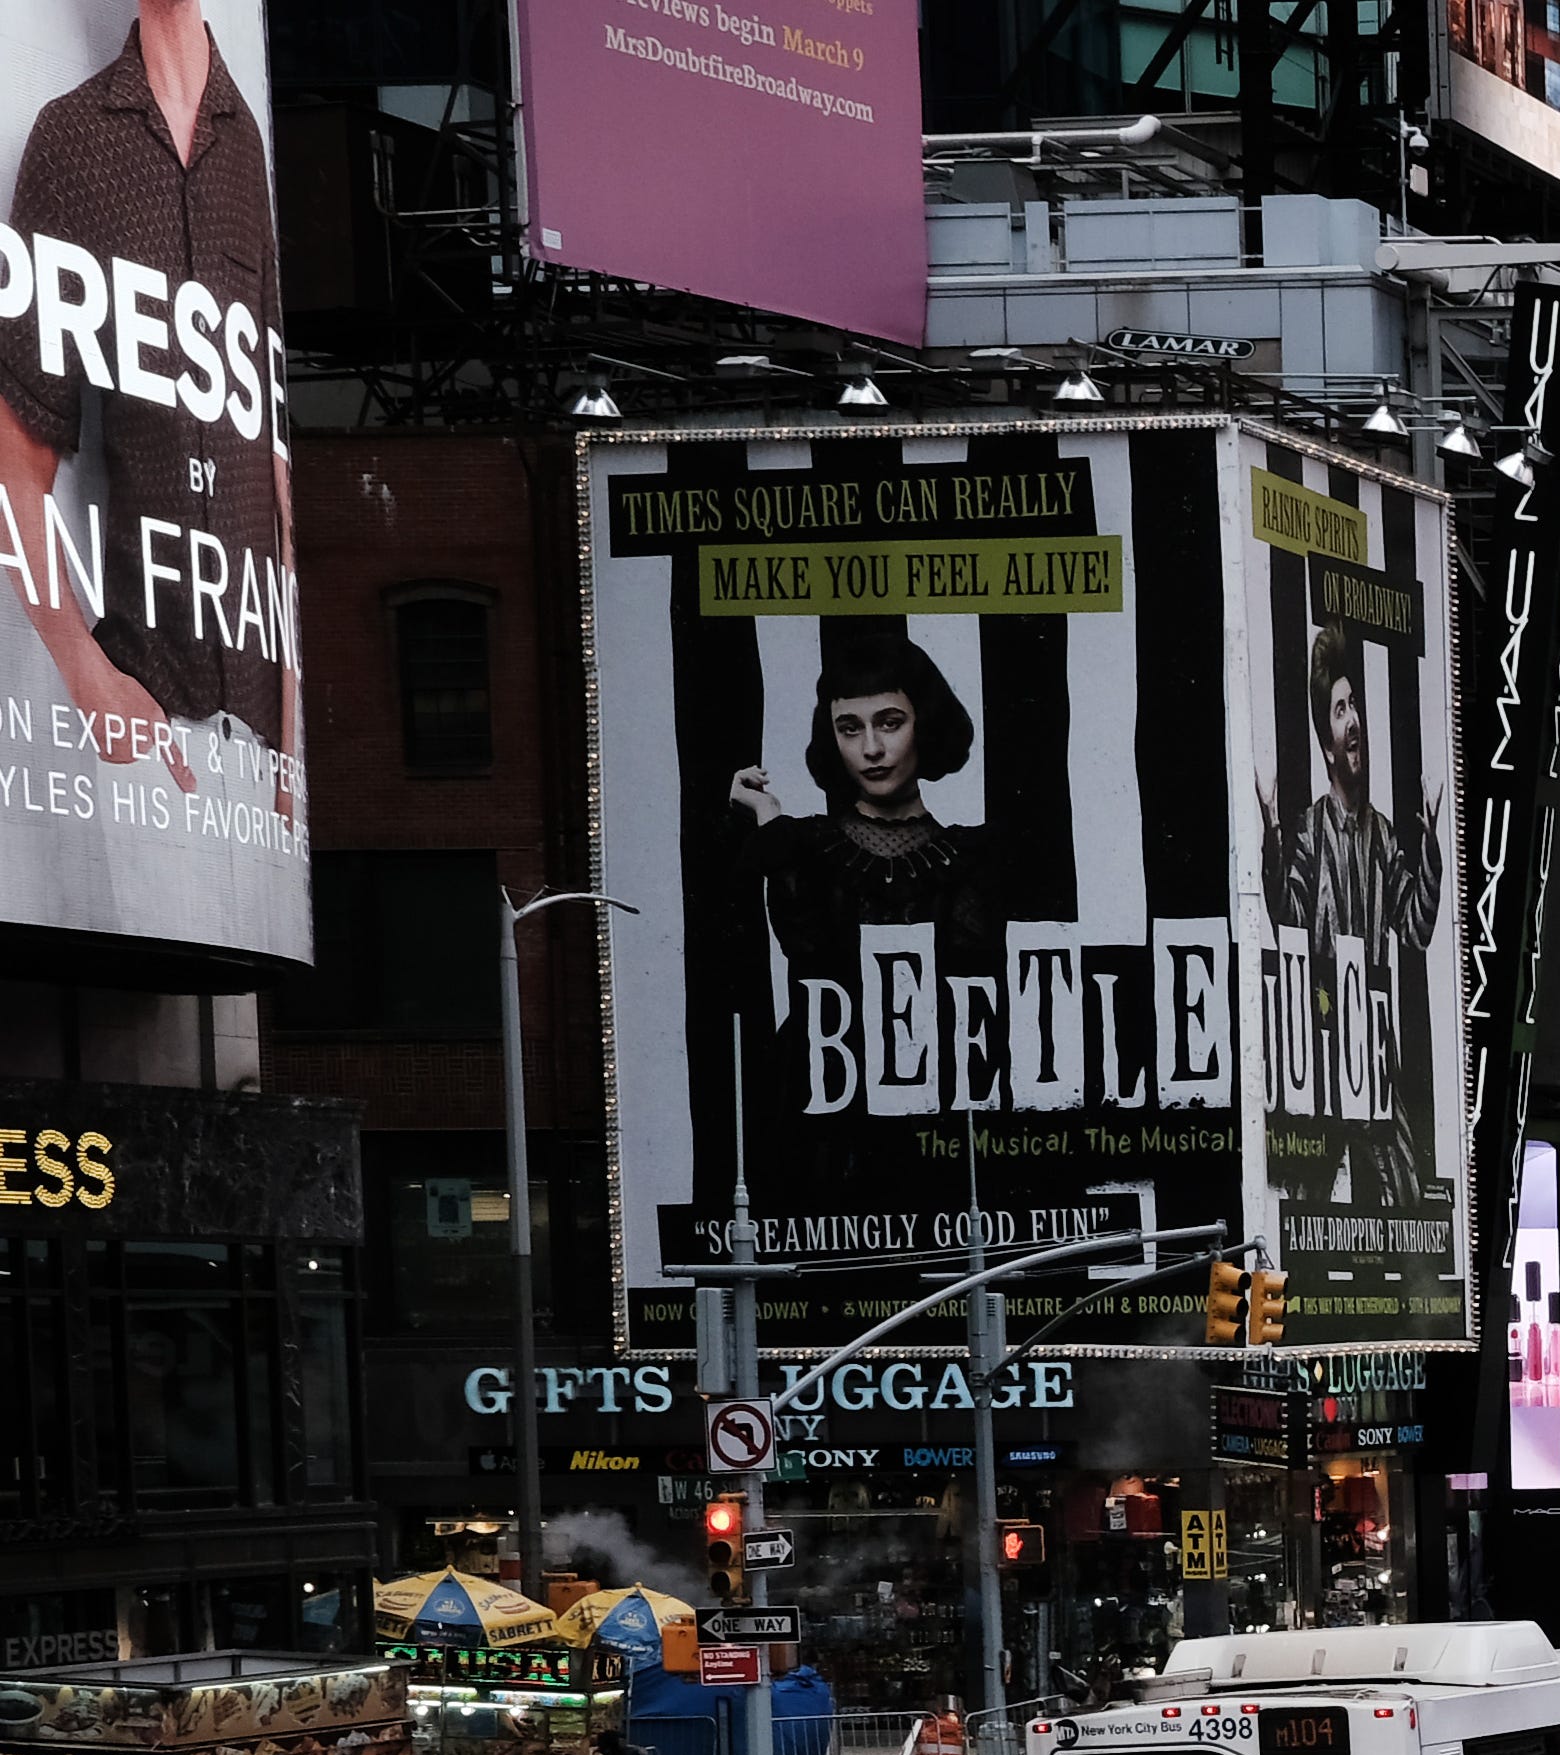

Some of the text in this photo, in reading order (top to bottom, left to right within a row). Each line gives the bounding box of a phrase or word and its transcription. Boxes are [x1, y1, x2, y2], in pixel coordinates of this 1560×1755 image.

[716, 4, 776, 46] begin
[782, 24, 850, 69] March
[852, 48, 864, 72] 9
[604, 24, 874, 124] MrsDoubtfireBroadway.com
[1120, 332, 1243, 357] LAMAR
[188, 456, 217, 498] BY
[622, 472, 1077, 537] TIMES SQUARE CAN REALLY
[1262, 486, 1359, 561] RAISING SPIRITS
[712, 550, 1110, 600] MAKE YOU FEEL ALIVE!
[1323, 570, 1412, 634] ON BROADWAY!
[51, 704, 262, 783] EXPERT & TV
[799, 944, 1230, 1115] BEETLE
[916, 1127, 962, 1159] The
[1084, 1122, 1134, 1156] The
[569, 1449, 640, 1471] Nikon
[800, 1449, 880, 1467] SONY
[747, 1541, 786, 1559] ONE WAY
[1187, 1514, 1206, 1569] ATM
[488, 1617, 556, 1644] SABRETT
[711, 1616, 786, 1633] ONE WAY
[5, 1629, 118, 1666] EXPRESS
[1081, 1716, 1253, 1742] New York City Bus 4398
